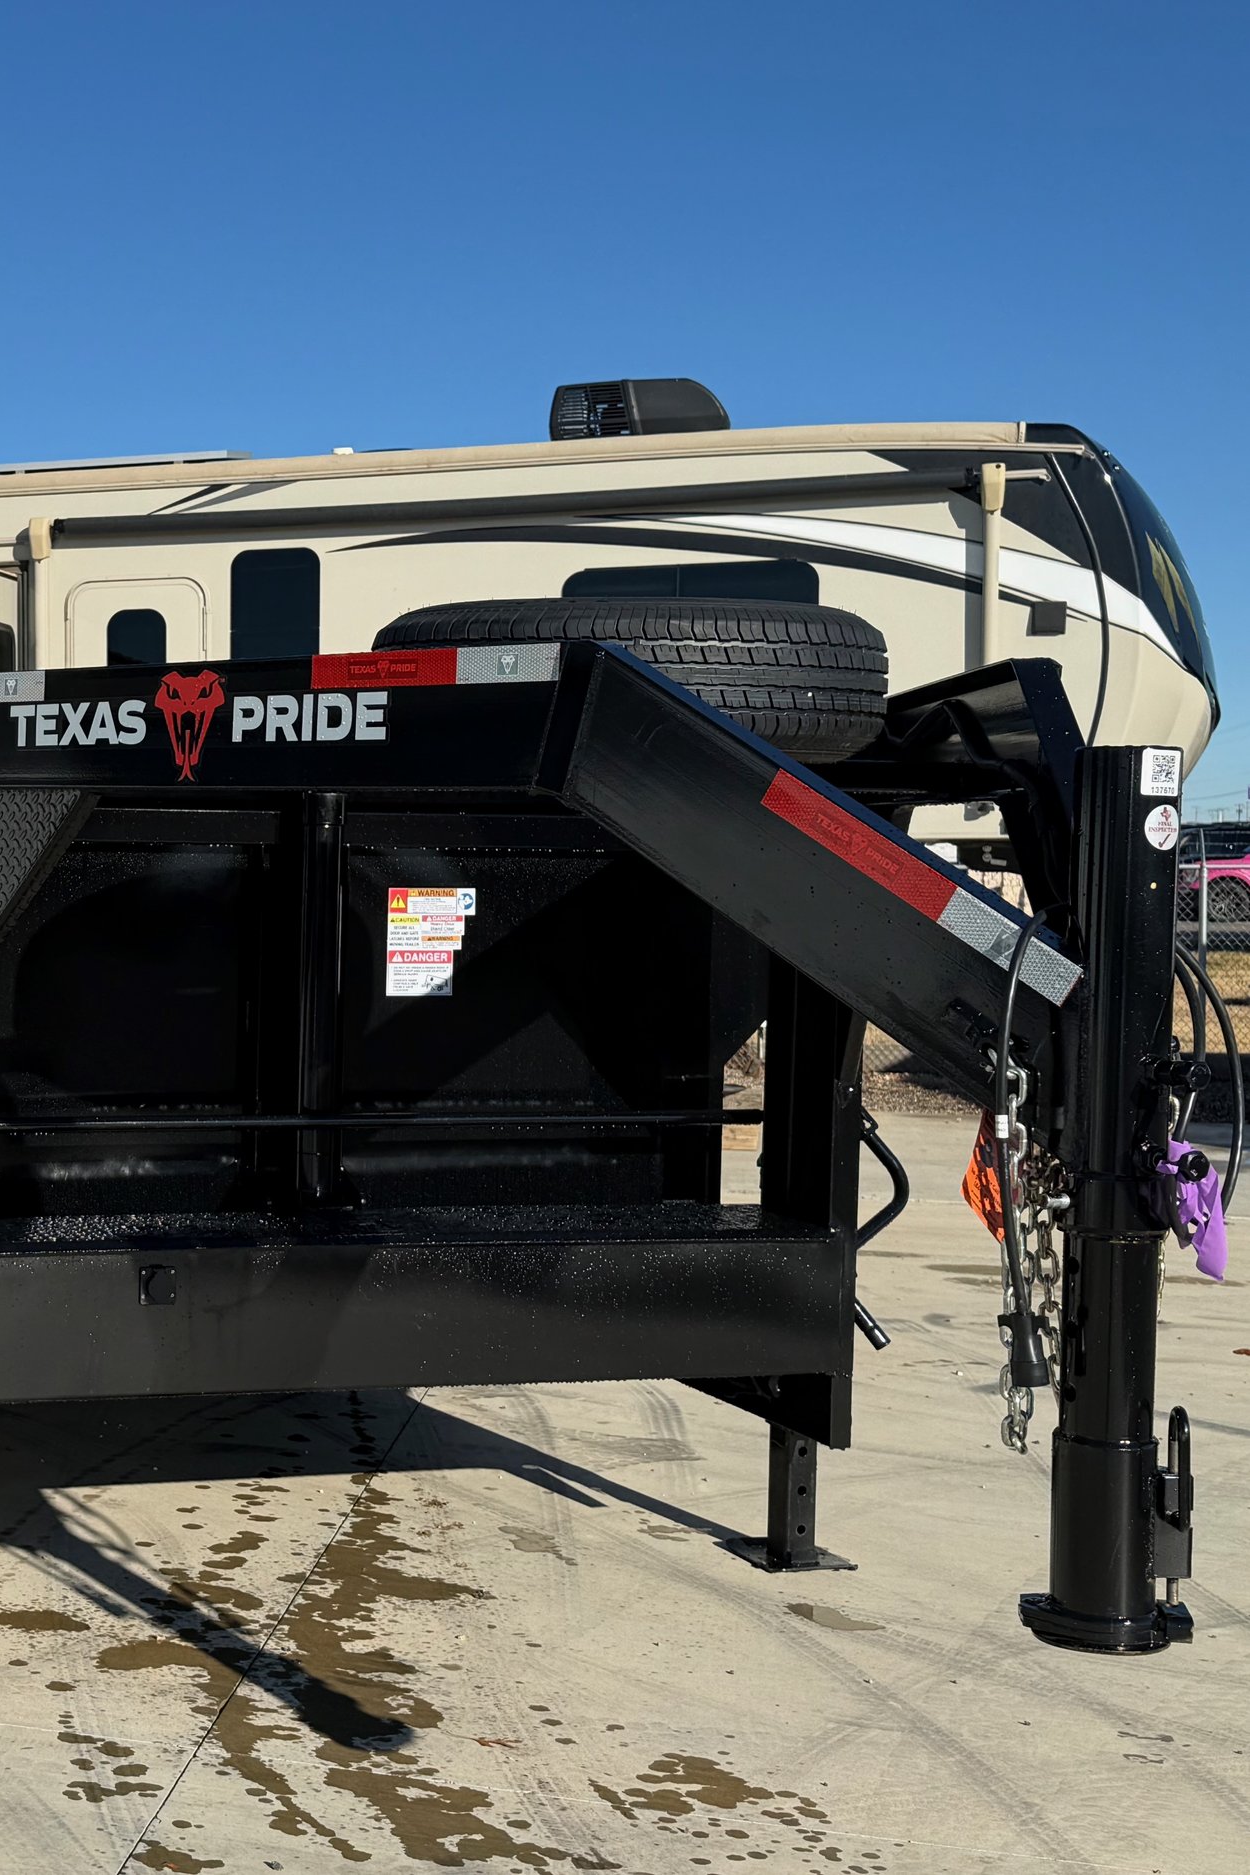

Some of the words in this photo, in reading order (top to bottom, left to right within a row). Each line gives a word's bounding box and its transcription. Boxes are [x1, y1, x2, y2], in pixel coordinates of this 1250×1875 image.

[350, 665, 376, 674] TEXAS
[390, 664, 416, 672] PRIDE
[10, 700, 146, 748] TEXAS
[231, 691, 389, 743] PRIDE
[816, 814, 850, 841] TEXAS
[866, 847, 900, 876] PRIDE
[417, 889, 455, 897] WARNING
[404, 952, 448, 962] DANGER
